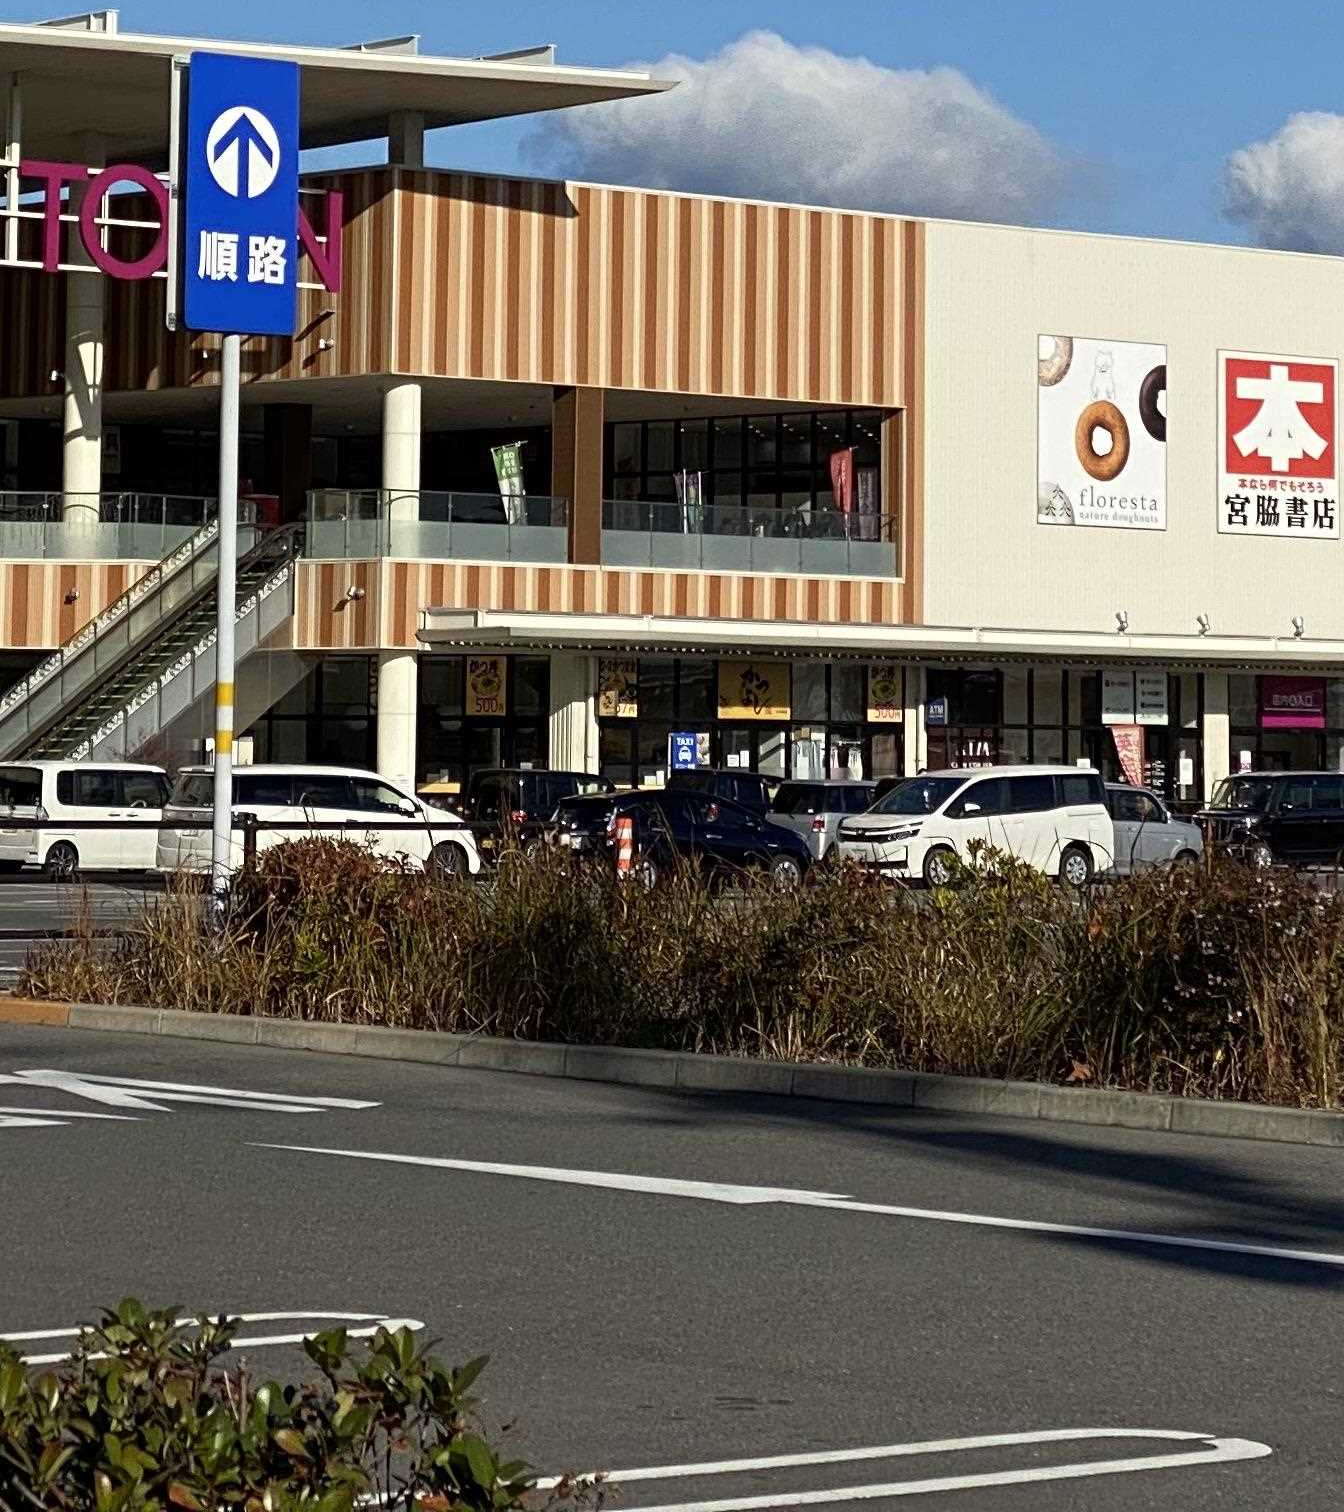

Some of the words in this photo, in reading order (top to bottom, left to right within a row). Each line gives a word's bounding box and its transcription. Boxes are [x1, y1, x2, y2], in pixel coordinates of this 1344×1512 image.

[20, 160, 342, 293] TON
[197, 230, 287, 285] 順路
[1079, 485, 1158, 511] floresta
[1225, 494, 1336, 530] 宮脇書店
